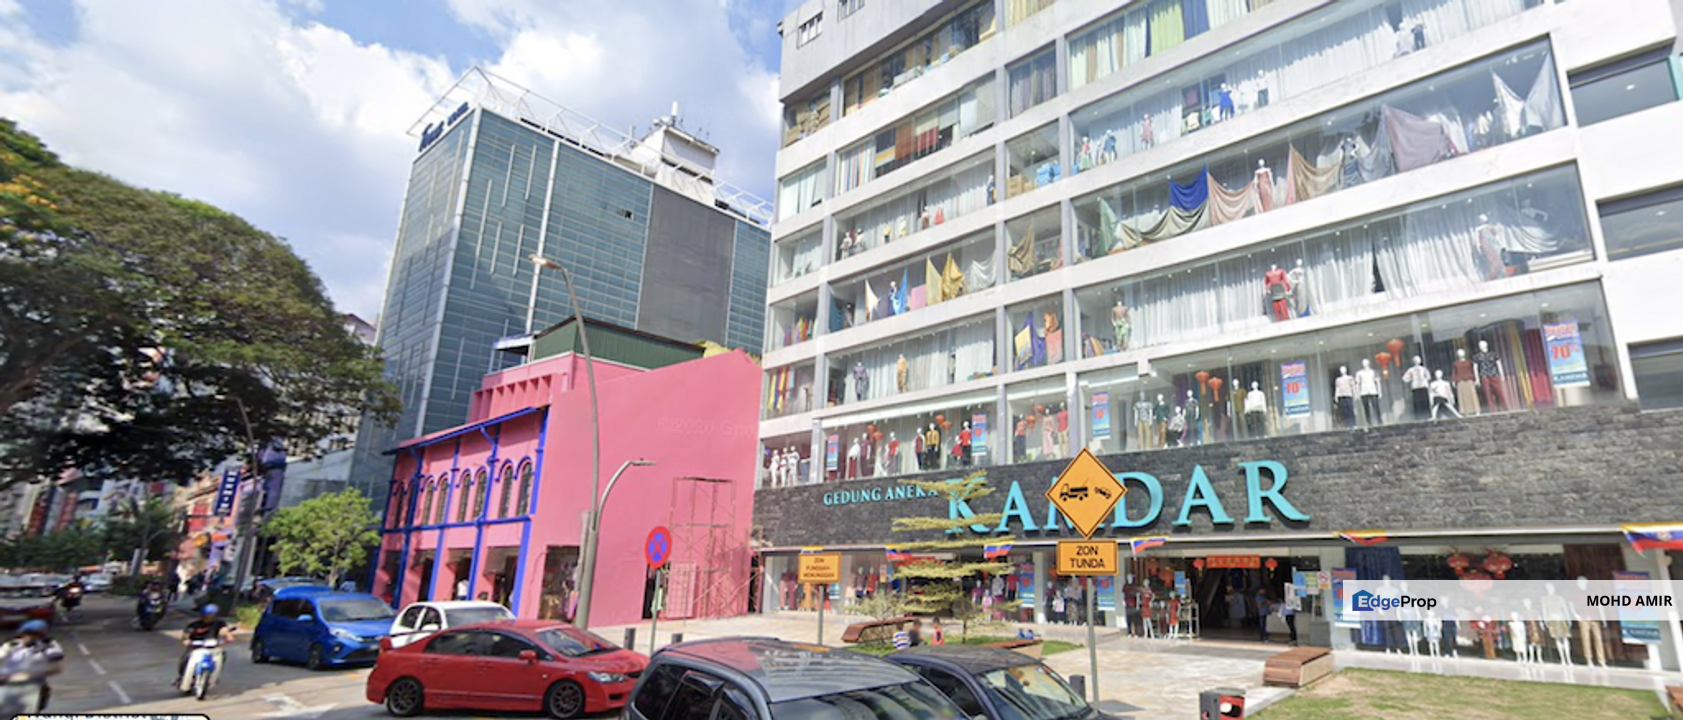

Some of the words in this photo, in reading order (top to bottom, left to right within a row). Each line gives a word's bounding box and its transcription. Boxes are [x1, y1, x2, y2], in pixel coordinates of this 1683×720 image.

[823, 487, 882, 506] GEDUNG
[1076, 545, 1098, 556] ZON
[1069, 558, 1105, 568] TUNDA
